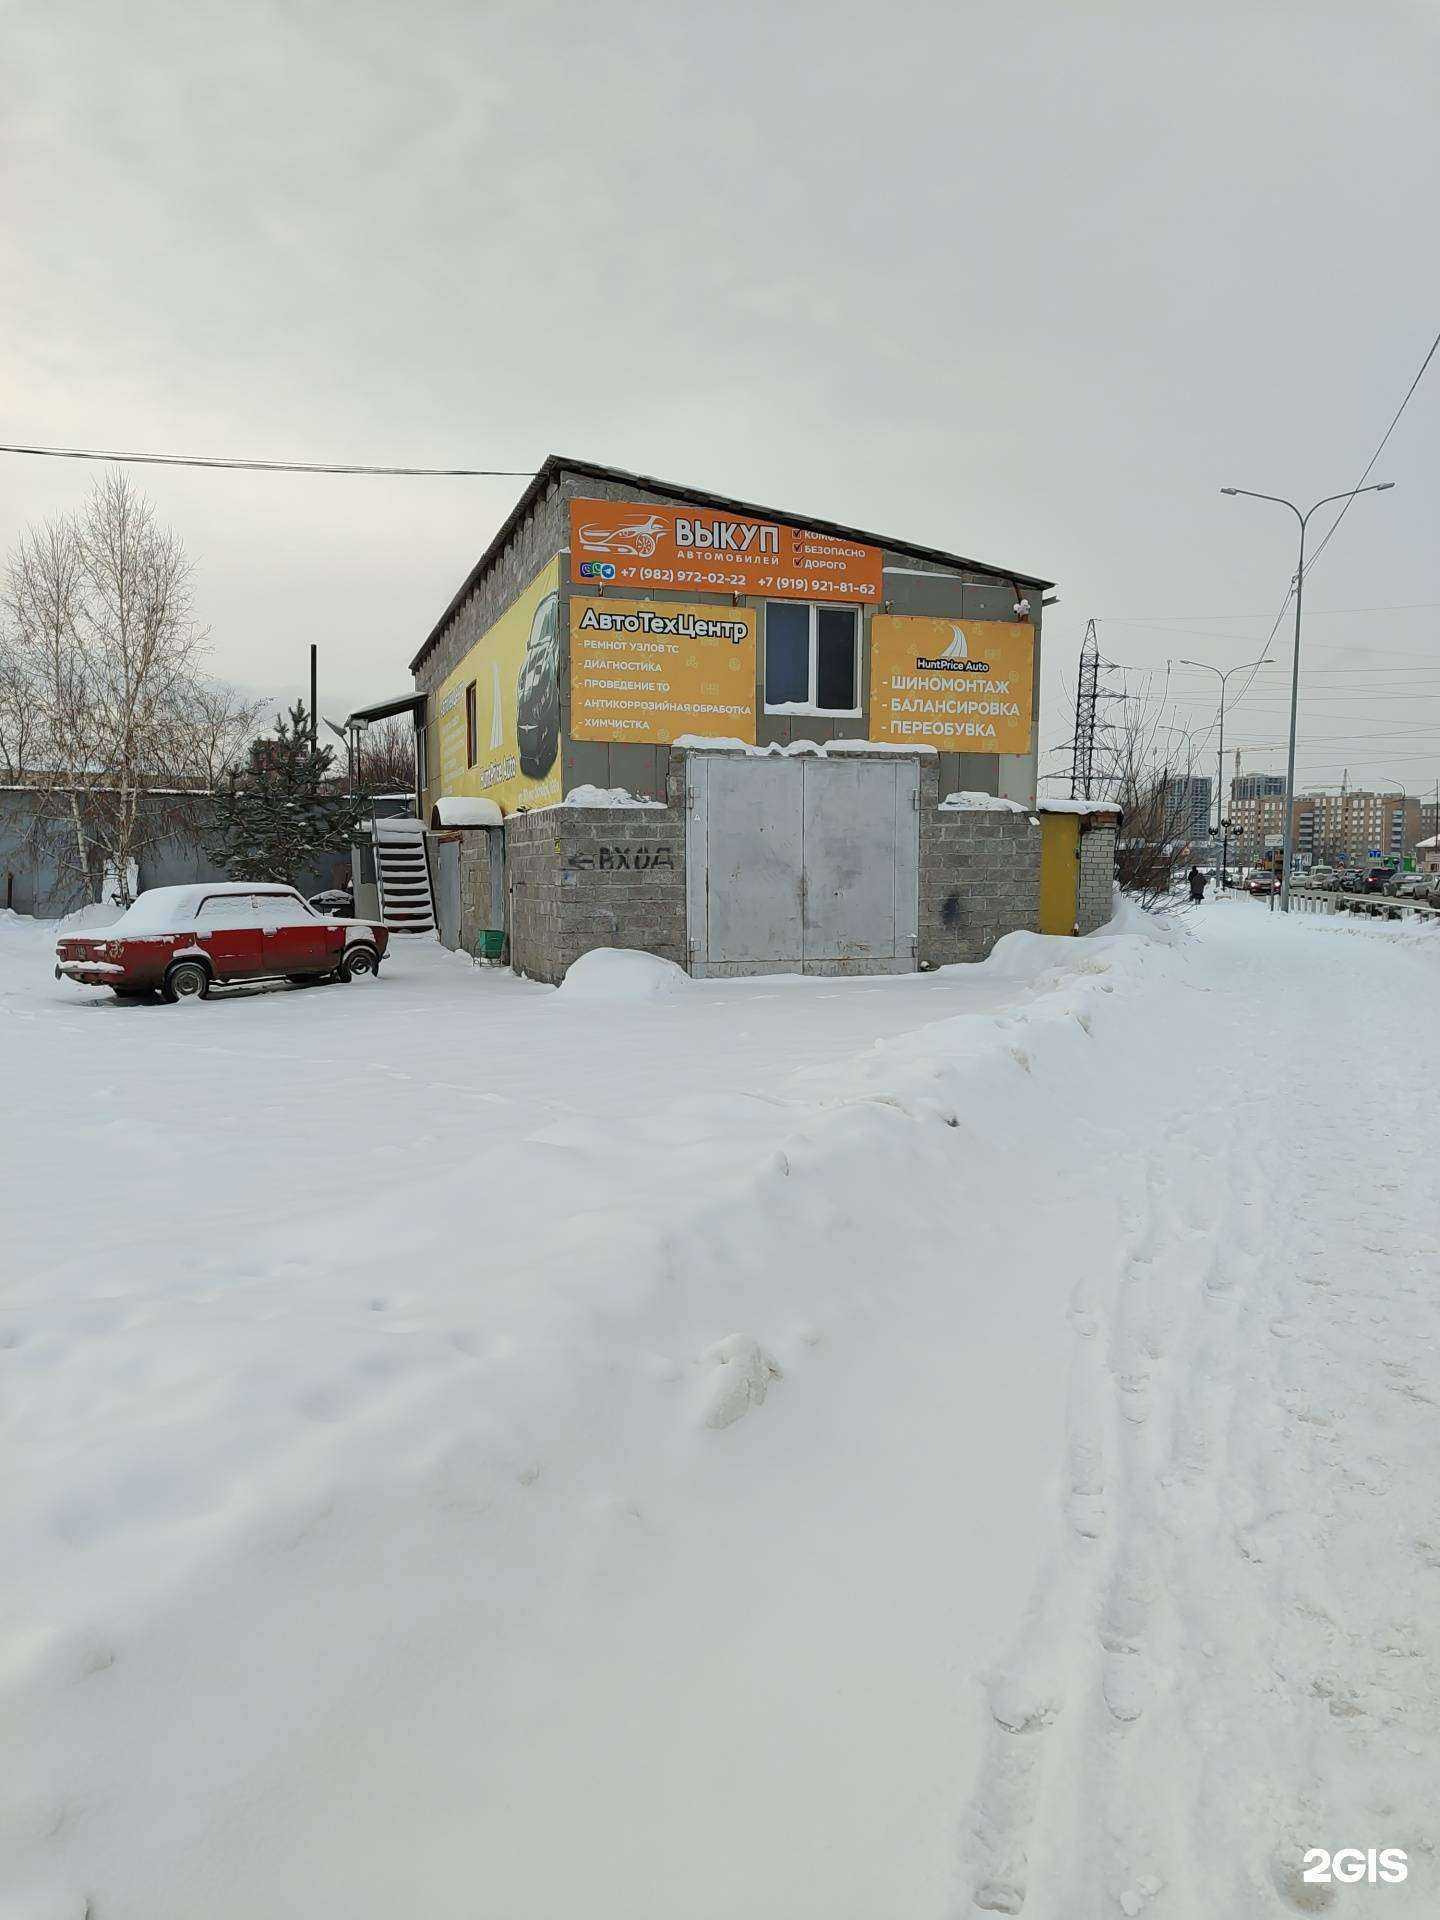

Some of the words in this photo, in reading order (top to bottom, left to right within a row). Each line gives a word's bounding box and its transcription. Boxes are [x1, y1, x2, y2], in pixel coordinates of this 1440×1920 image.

[676, 518, 779, 554] ВЫКУП
[677, 550, 779, 566] АВТОМОБИЛЕЙ
[804, 545, 866, 558] БЕЗОПАСНО
[804, 559, 847, 570] ДОРОГО
[621, 567, 637, 579] +7
[639, 569, 674, 583] (982)
[677, 570, 746, 586] 972-02-22
[758, 576, 773, 588] +7
[776, 577, 808, 592] (919)
[811, 580, 876, 595] 921-81-62
[579, 607, 748, 644] АвтоТехЦентр
[583, 639, 627, 650] РЕМНОТ
[630, 642, 665, 652] УЗЛОВ
[667, 644, 680, 653] ТС
[583, 659, 662, 672] ДИАГНОСТИКА
[917, 658, 964, 671] HuntPrice
[965, 663, 990, 672] Auto
[584, 678, 655, 691] ПРОВЕДЕНИЕ
[657, 682, 670, 692] ТО
[891, 675, 1010, 693] ШИНОМОНТАЖ
[584, 698, 691, 712] АНТИКОРРОЗИЙНАЯ
[692, 704, 752, 714] ОБРАБОТКА
[891, 697, 1020, 716] БАЛАНСИРОВКА
[584, 717, 650, 729] ХИМЧИСТКА
[890, 719, 996, 737] ПЕРЕОБУВКА
